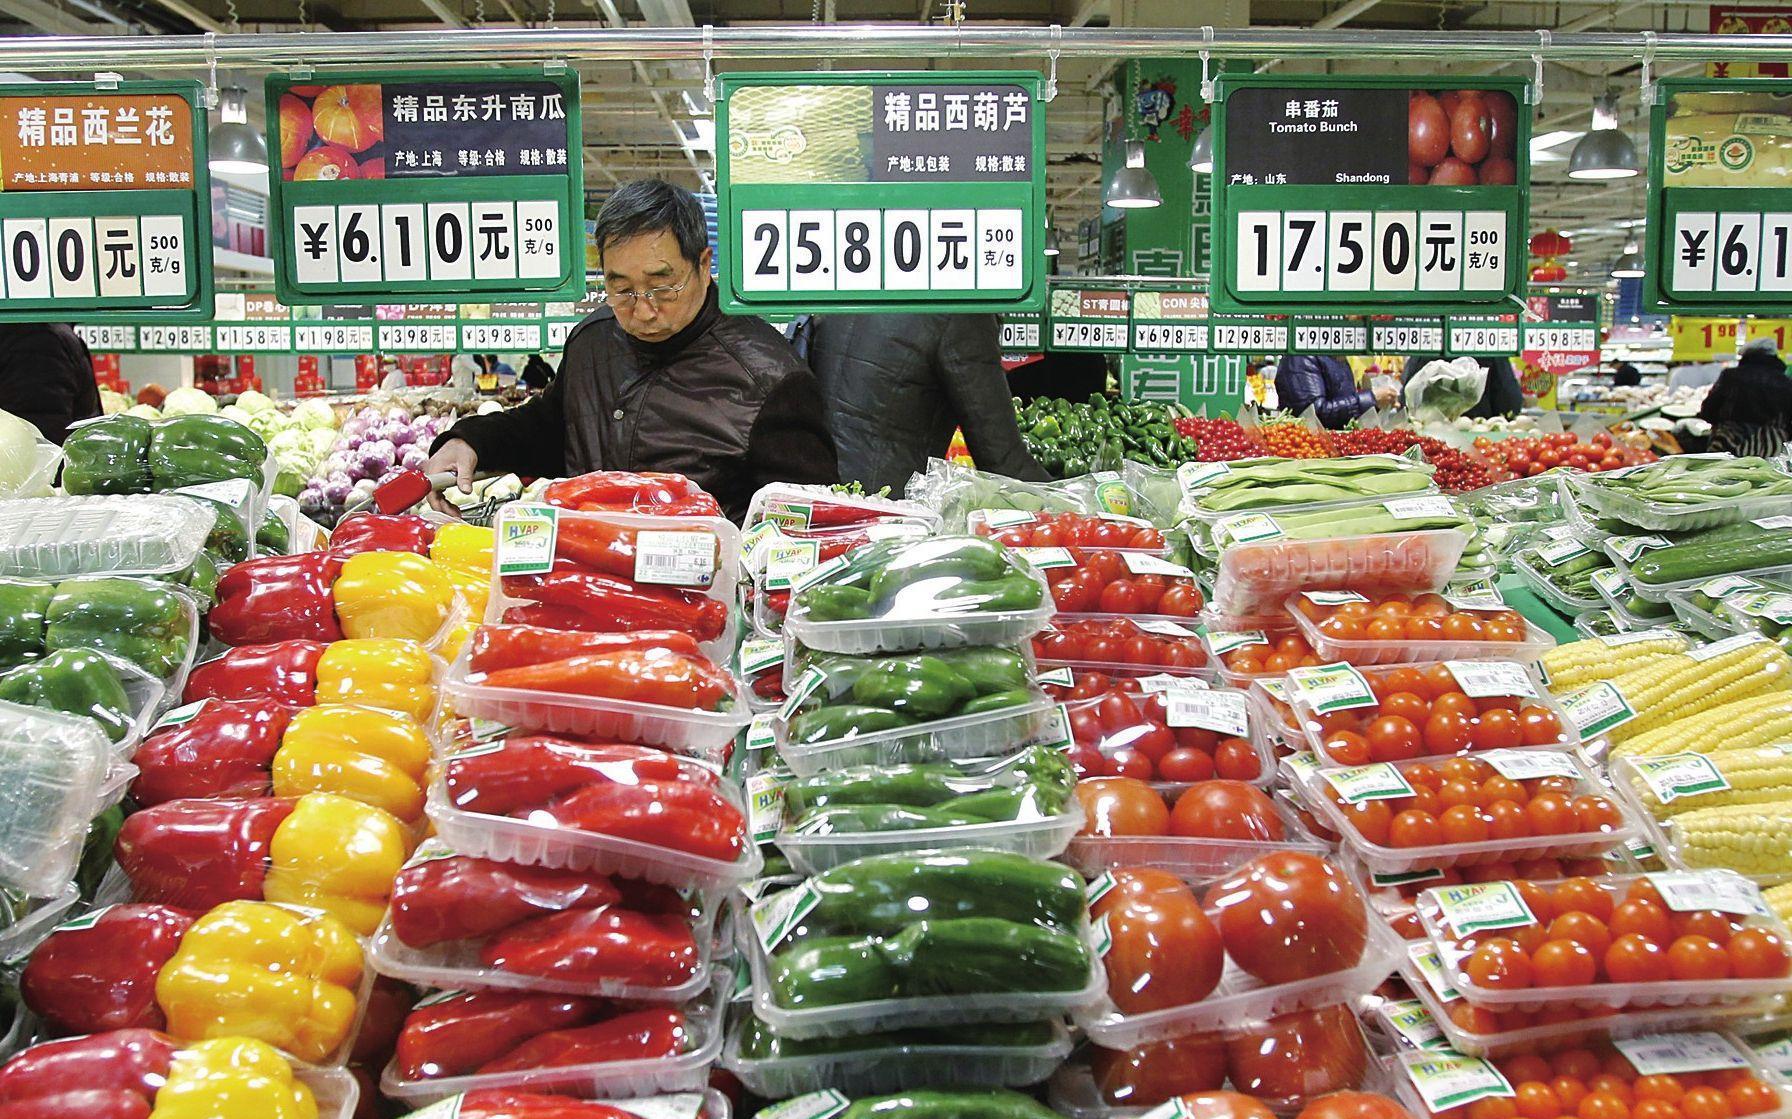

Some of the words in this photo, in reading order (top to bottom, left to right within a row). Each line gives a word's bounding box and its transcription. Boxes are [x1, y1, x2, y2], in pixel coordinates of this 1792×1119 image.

[393, 94, 566, 123] 精品东升南瓜
[885, 92, 1029, 131] 精品西葫芦
[1286, 100, 1339, 118] 串番茄
[18, 107, 174, 146] 精品西兰花
[1269, 121, 1316, 133] Tomato
[1319, 121, 1358, 133] Bunch
[1335, 173, 1390, 184] Shandong
[525, 218, 553, 232] 500
[150, 235, 179, 249] 500
[985, 229, 1014, 242] 500
[1470, 230, 1498, 244] 500
[525, 239, 554, 255] 克/g
[150, 257, 180, 274] 克/g
[984, 250, 1014, 266] 克/g
[1469, 252, 1499, 270] 克/g
[1163, 300, 1188, 310] CON
[510, 525, 539, 538] HVAP
[1449, 885, 1488, 902] HVAP
